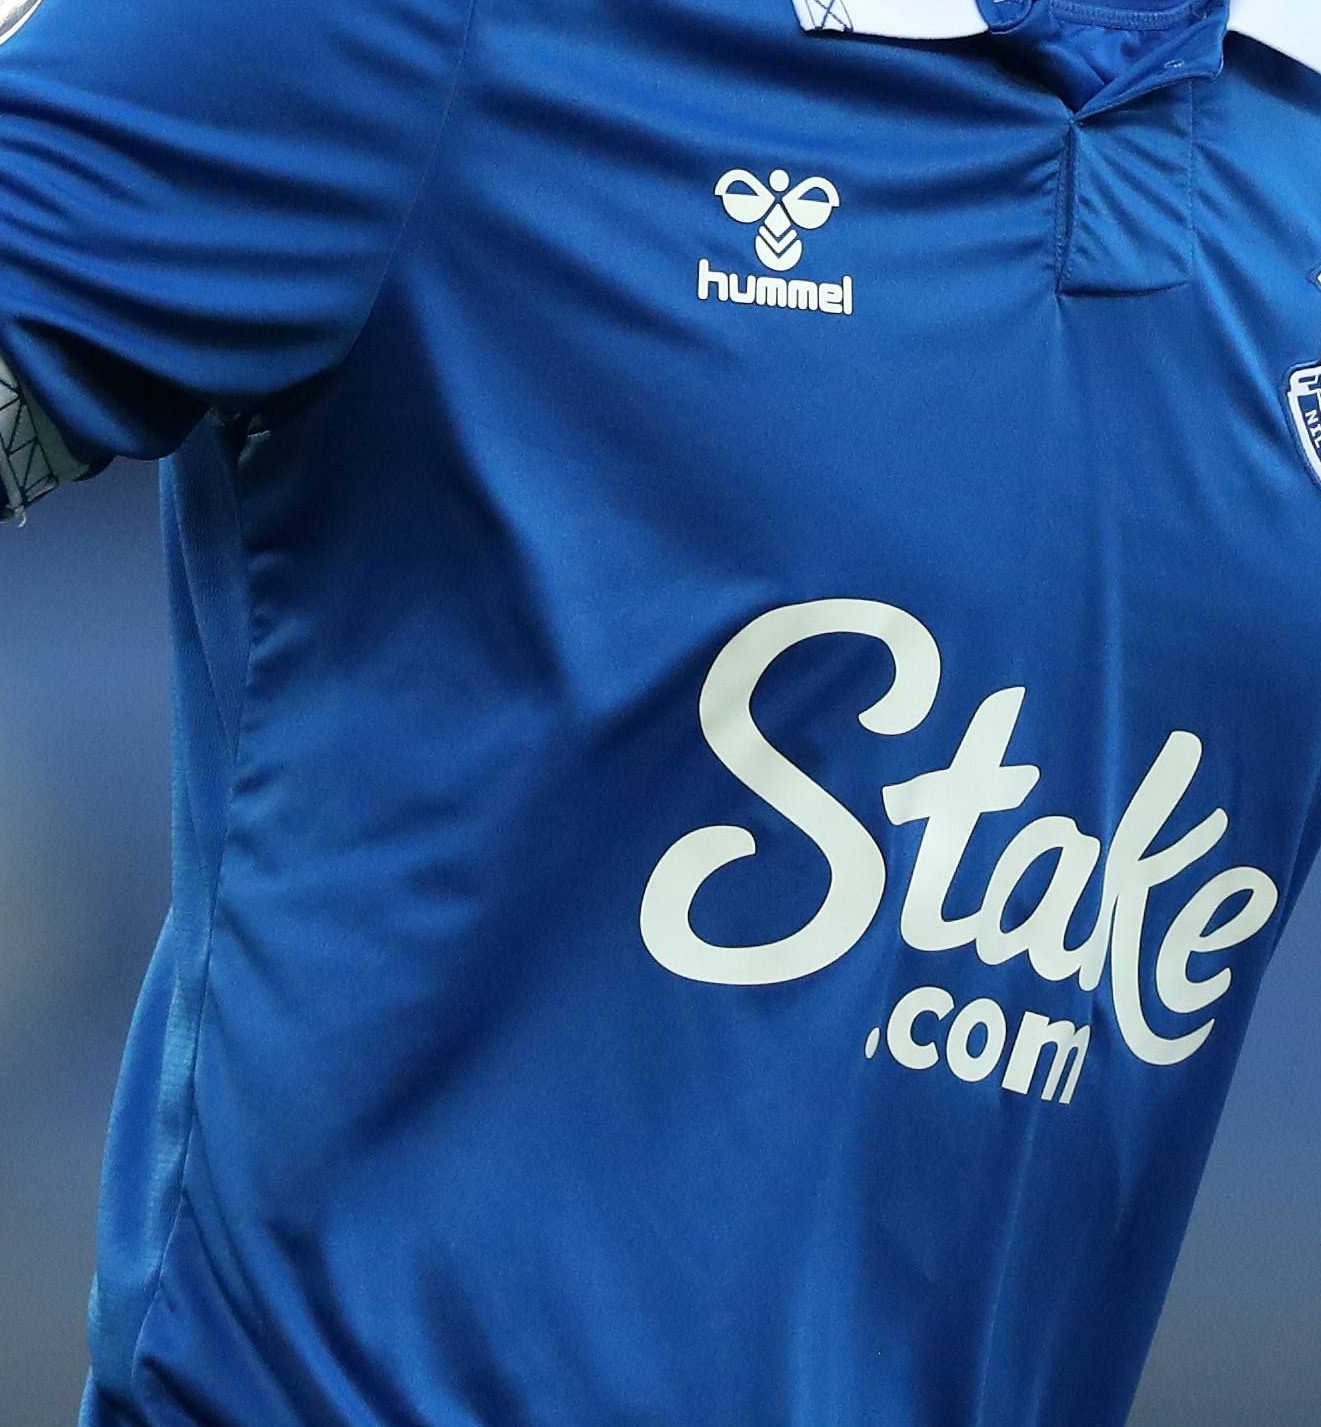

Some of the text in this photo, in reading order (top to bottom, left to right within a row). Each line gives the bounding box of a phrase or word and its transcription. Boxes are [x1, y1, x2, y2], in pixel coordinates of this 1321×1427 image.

[697, 258, 854, 316] hummel
[640, 597, 1279, 1066] Stake
[864, 987, 1092, 1104] .com
